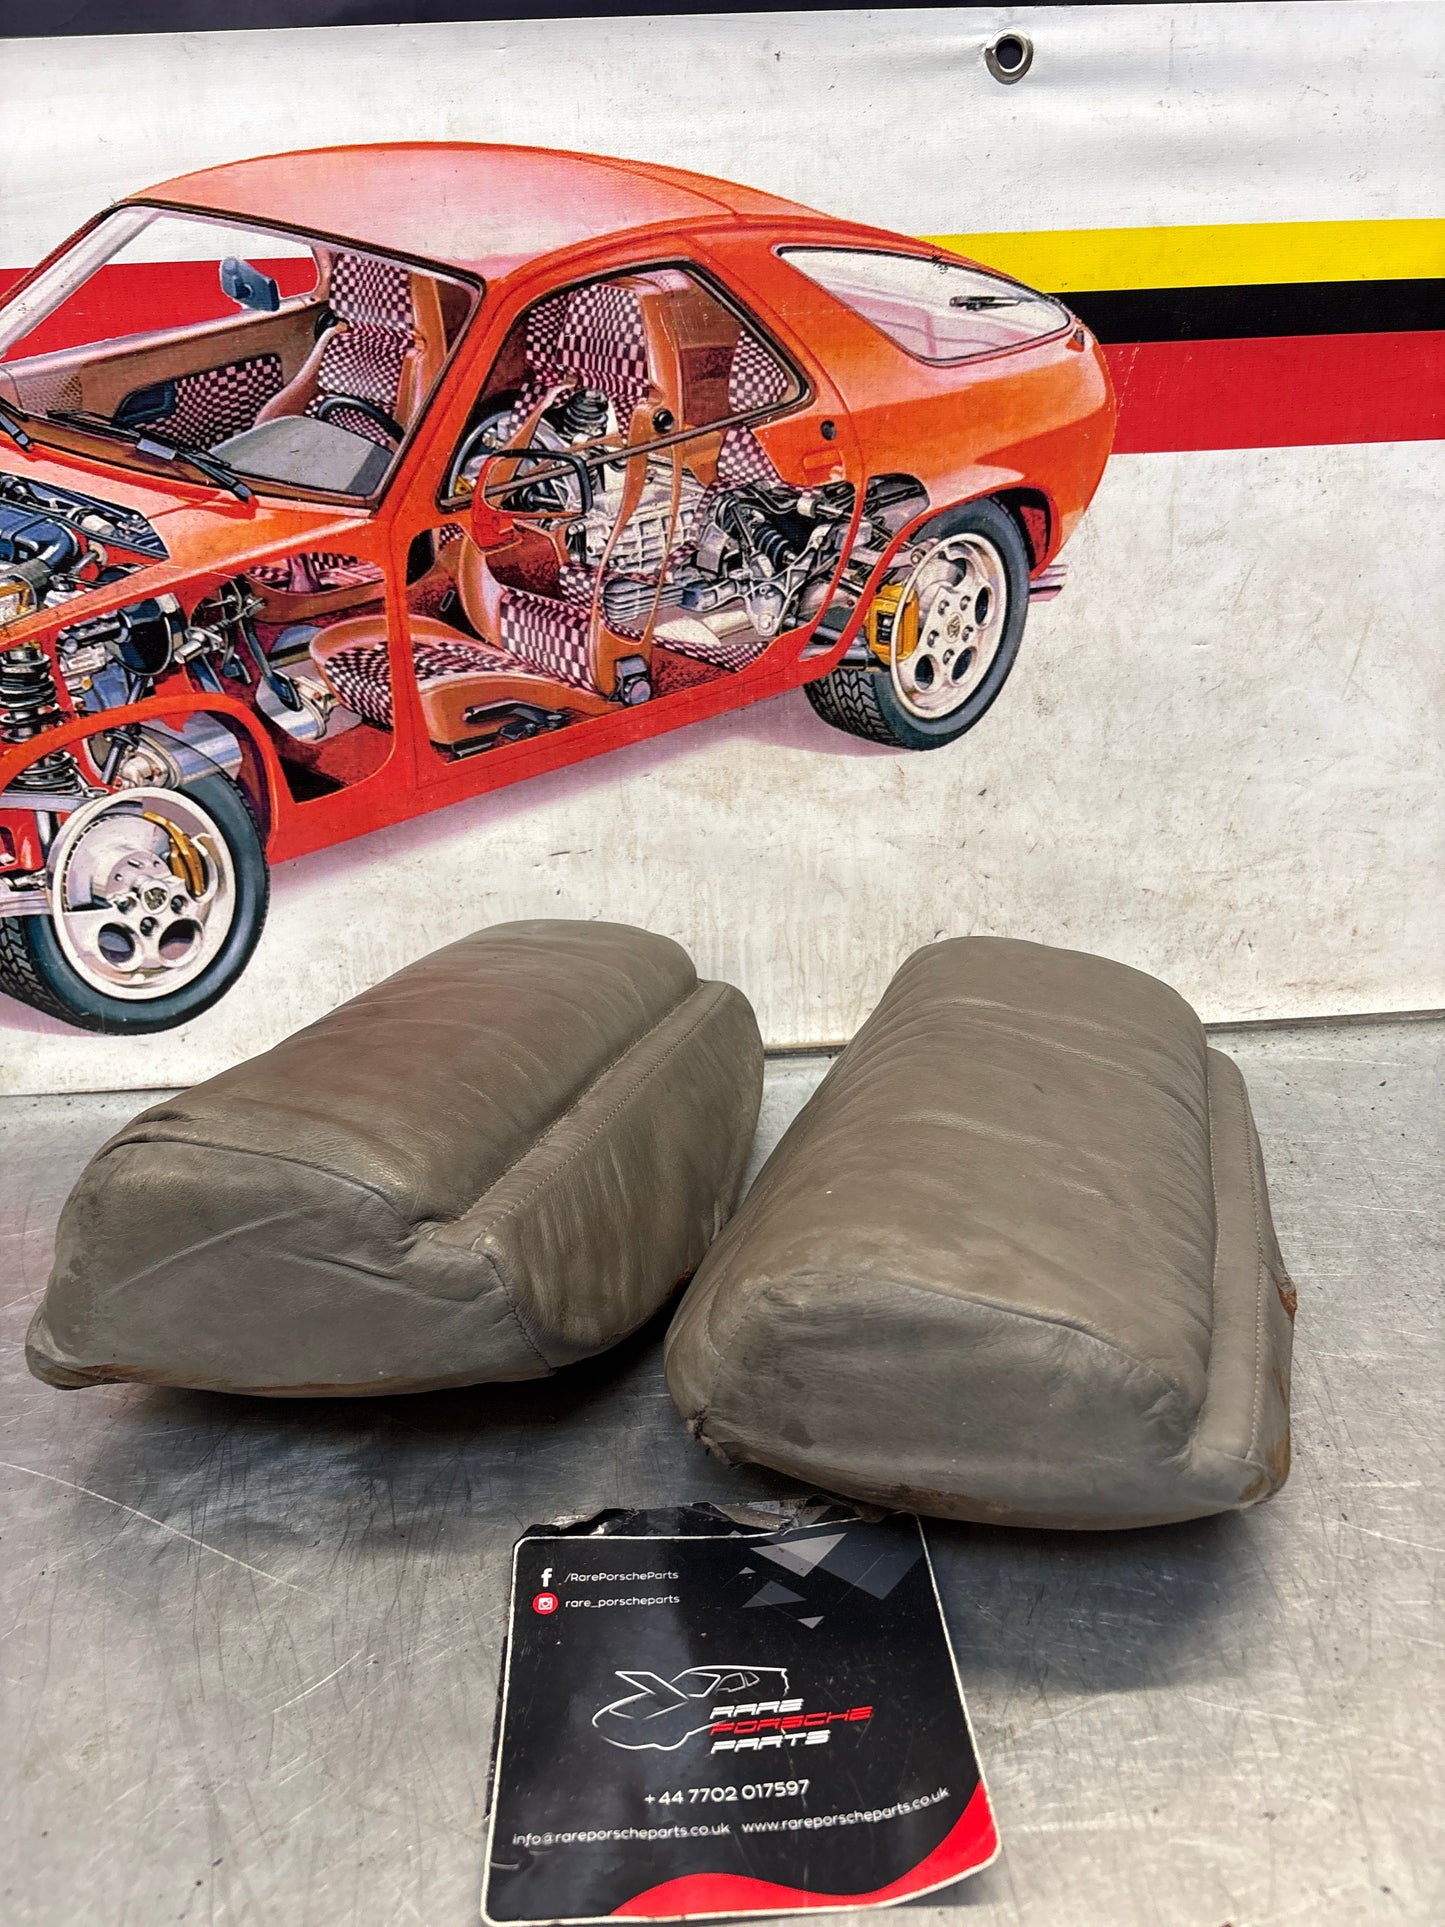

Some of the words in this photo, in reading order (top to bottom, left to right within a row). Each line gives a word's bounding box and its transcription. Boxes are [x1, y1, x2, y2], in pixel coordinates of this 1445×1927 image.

[564, 1570, 680, 1583] /RarePorscheParts
[565, 1594, 680, 1609] rare_porscheparts
[710, 1698, 804, 1719] RARE
[710, 1706, 873, 1736] PORSCHE
[710, 1729, 831, 1754] PARTS
[688, 1786, 737, 1803] 7702
[742, 1780, 810, 1800] 017597
[512, 1822, 731, 1846] info@rareporscheparts.co.uk
[741, 1787, 950, 1833] www.rareporscheparts.co.uk
